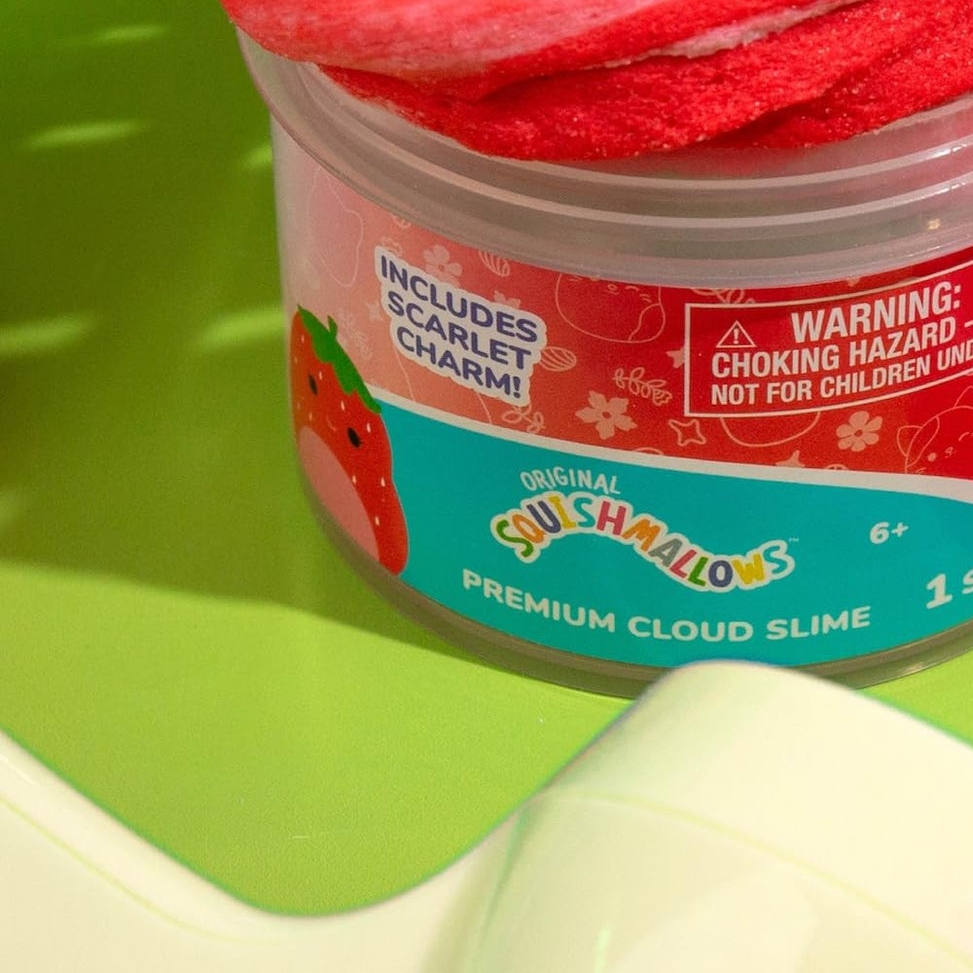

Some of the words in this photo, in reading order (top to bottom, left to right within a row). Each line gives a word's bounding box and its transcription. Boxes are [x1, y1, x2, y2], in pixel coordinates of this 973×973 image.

[381, 255, 537, 343] INCLUDES
[388, 291, 531, 370] SCARLET
[791, 281, 961, 344] WARNING:
[397, 327, 521, 399] CHARM!
[711, 344, 840, 379] CHOKING
[849, 316, 956, 367] HAZARD
[711, 383, 760, 406] NOT
[766, 378, 812, 405] FOR
[820, 356, 931, 398] CHILDREN
[520, 466, 621, 495] ORIGINAL
[492, 493, 792, 590] SQUISHMALLOWS
[869, 521, 910, 545] 6+
[462, 568, 616, 633] PREMIUM
[627, 615, 754, 643] CLOUD
[766, 605, 871, 640] SLIME
[926, 573, 953, 610] 1
